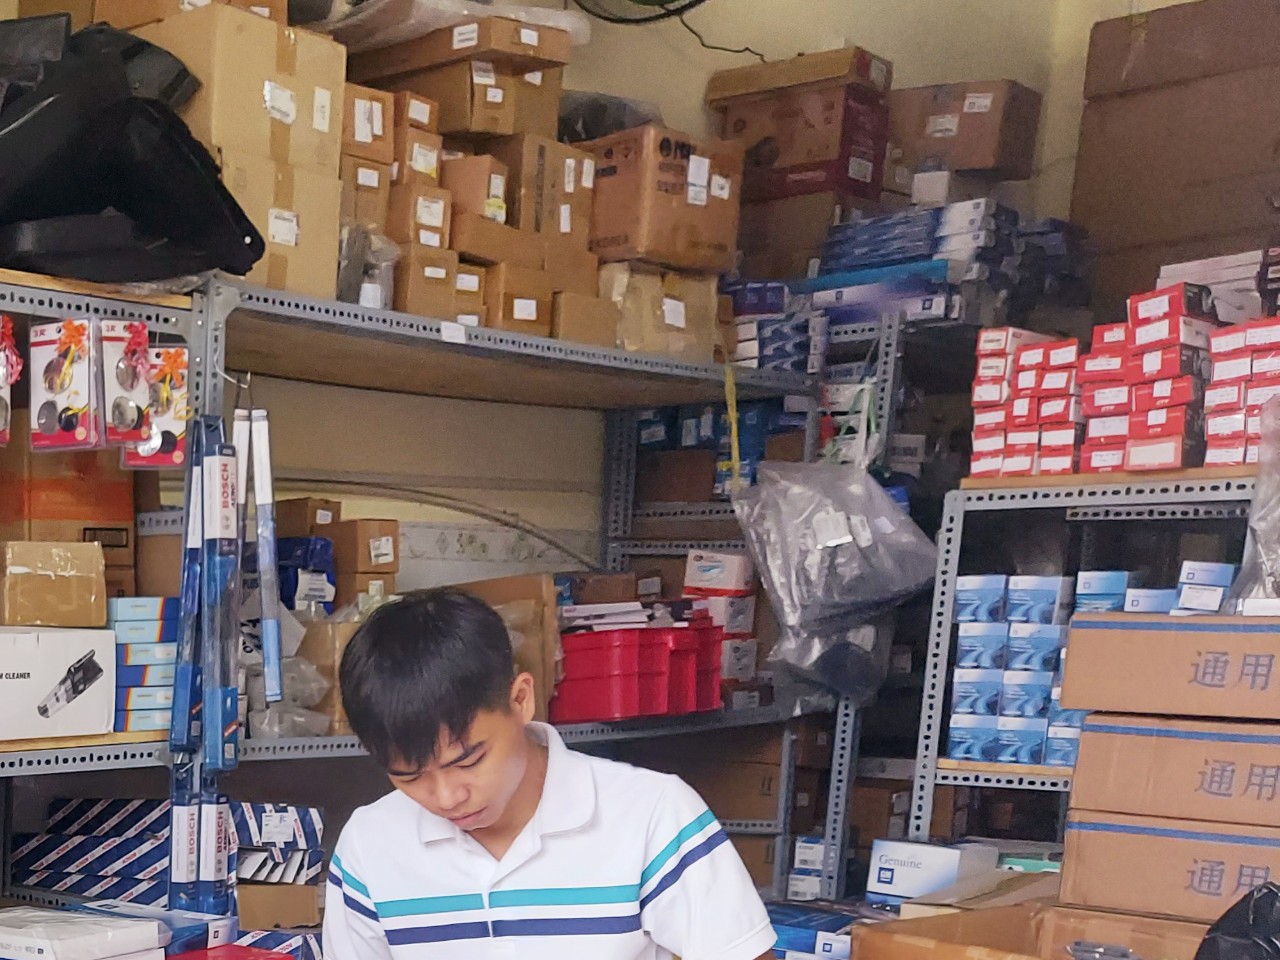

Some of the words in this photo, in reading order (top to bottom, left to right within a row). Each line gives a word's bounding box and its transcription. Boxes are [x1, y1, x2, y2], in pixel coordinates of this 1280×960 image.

[5, 672, 31, 680] CLEANER
[1187, 650, 1275, 691] 通用
[1195, 758, 1280, 801] 通用
[216, 810, 224, 853] BOSCH
[879, 853, 923, 868] Genuine
